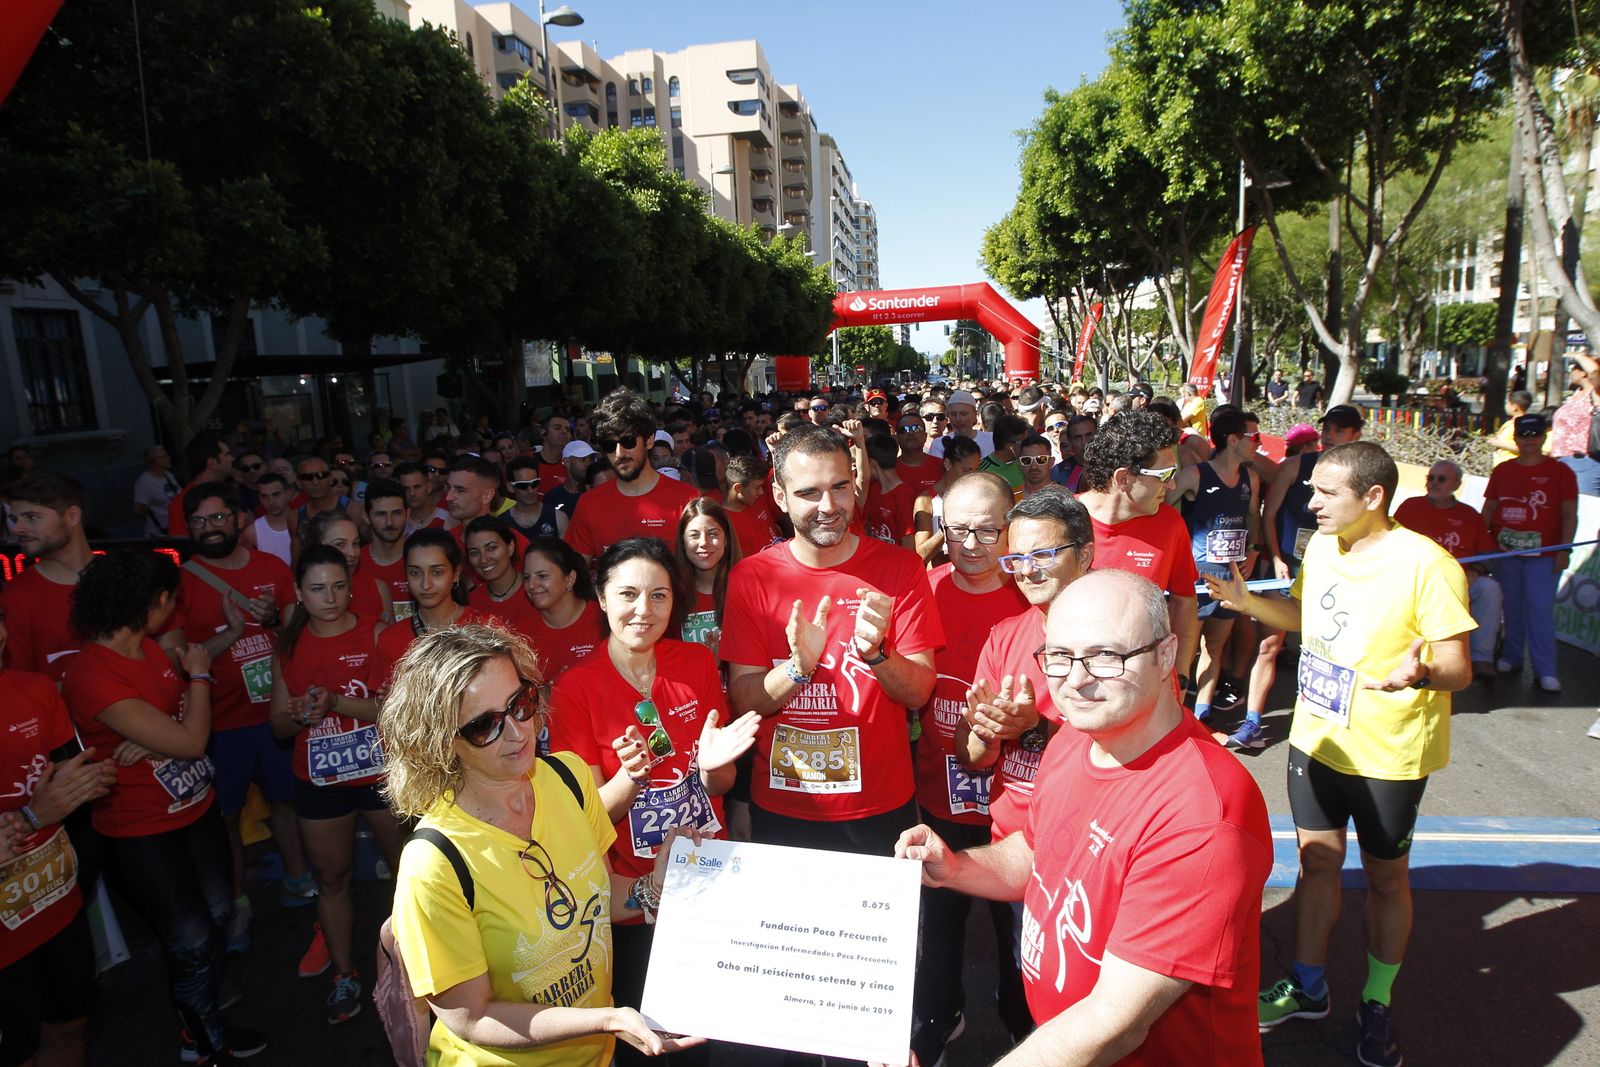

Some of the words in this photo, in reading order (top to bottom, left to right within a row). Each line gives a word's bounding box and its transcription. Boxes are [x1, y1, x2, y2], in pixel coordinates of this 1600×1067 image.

[868, 295, 940, 310] Santander
[1211, 539, 1241, 551] 2245
[1300, 665, 1339, 700] 2148
[790, 730, 797, 743] 6
[314, 744, 370, 770] 2016
[336, 762, 359, 774] MARINA
[779, 746, 845, 771] 3285
[171, 760, 207, 796] 2010
[650, 792, 659, 806] 6
[640, 794, 702, 834] 2223
[675, 854, 687, 864] La
[699, 856, 723, 868] Salle
[4, 851, 66, 904] 3017
[861, 900, 891, 911] 8.675
[760, 920, 810, 934] Fundacion
[813, 926, 836, 937] Poco
[838, 930, 889, 943] Frecuente
[730, 938, 779, 951] Investigacion
[781, 945, 835, 958] Enfermedades
[836, 952, 855, 960] Poco
[856, 955, 898, 966] Frecuentes
[532, 958, 593, 1004] CARRERA
[716, 960, 741, 971] Ocho
[743, 964, 760, 974] mil
[762, 967, 816, 981] seiscientos
[818, 975, 857, 986] setenta
[859, 980, 867, 989] y
[869, 980, 895, 991] cinco
[826, 1000, 836, 1008] de
[838, 1002, 858, 1012] junio
[860, 1005, 871, 1013] de
[872, 1006, 893, 1016] 2019
